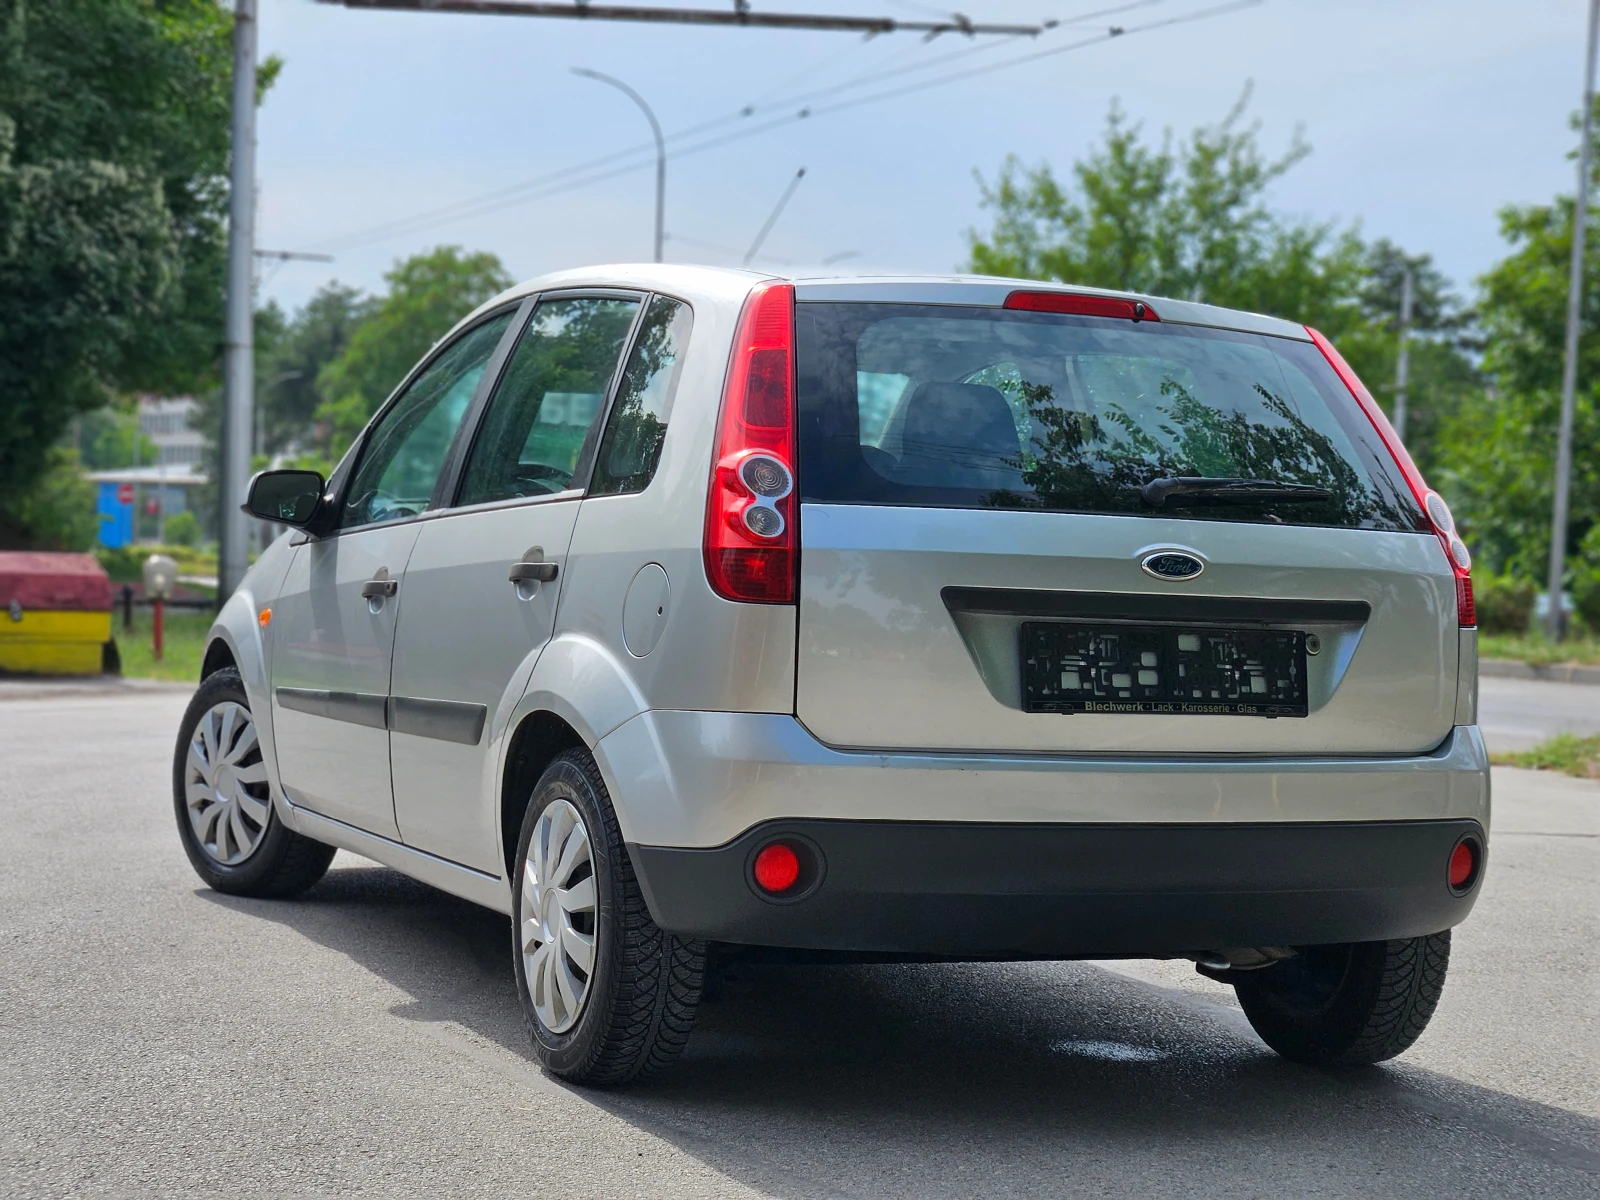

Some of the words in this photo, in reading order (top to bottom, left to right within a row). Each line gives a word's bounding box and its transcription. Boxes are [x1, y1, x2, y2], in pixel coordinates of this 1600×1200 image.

[1158, 557, 1192, 573] Ford
[1085, 701, 1144, 711] Blechwerk
[1151, 702, 1174, 712] Lack
[1181, 703, 1230, 713] Karosserie
[1237, 704, 1258, 714] Glas
